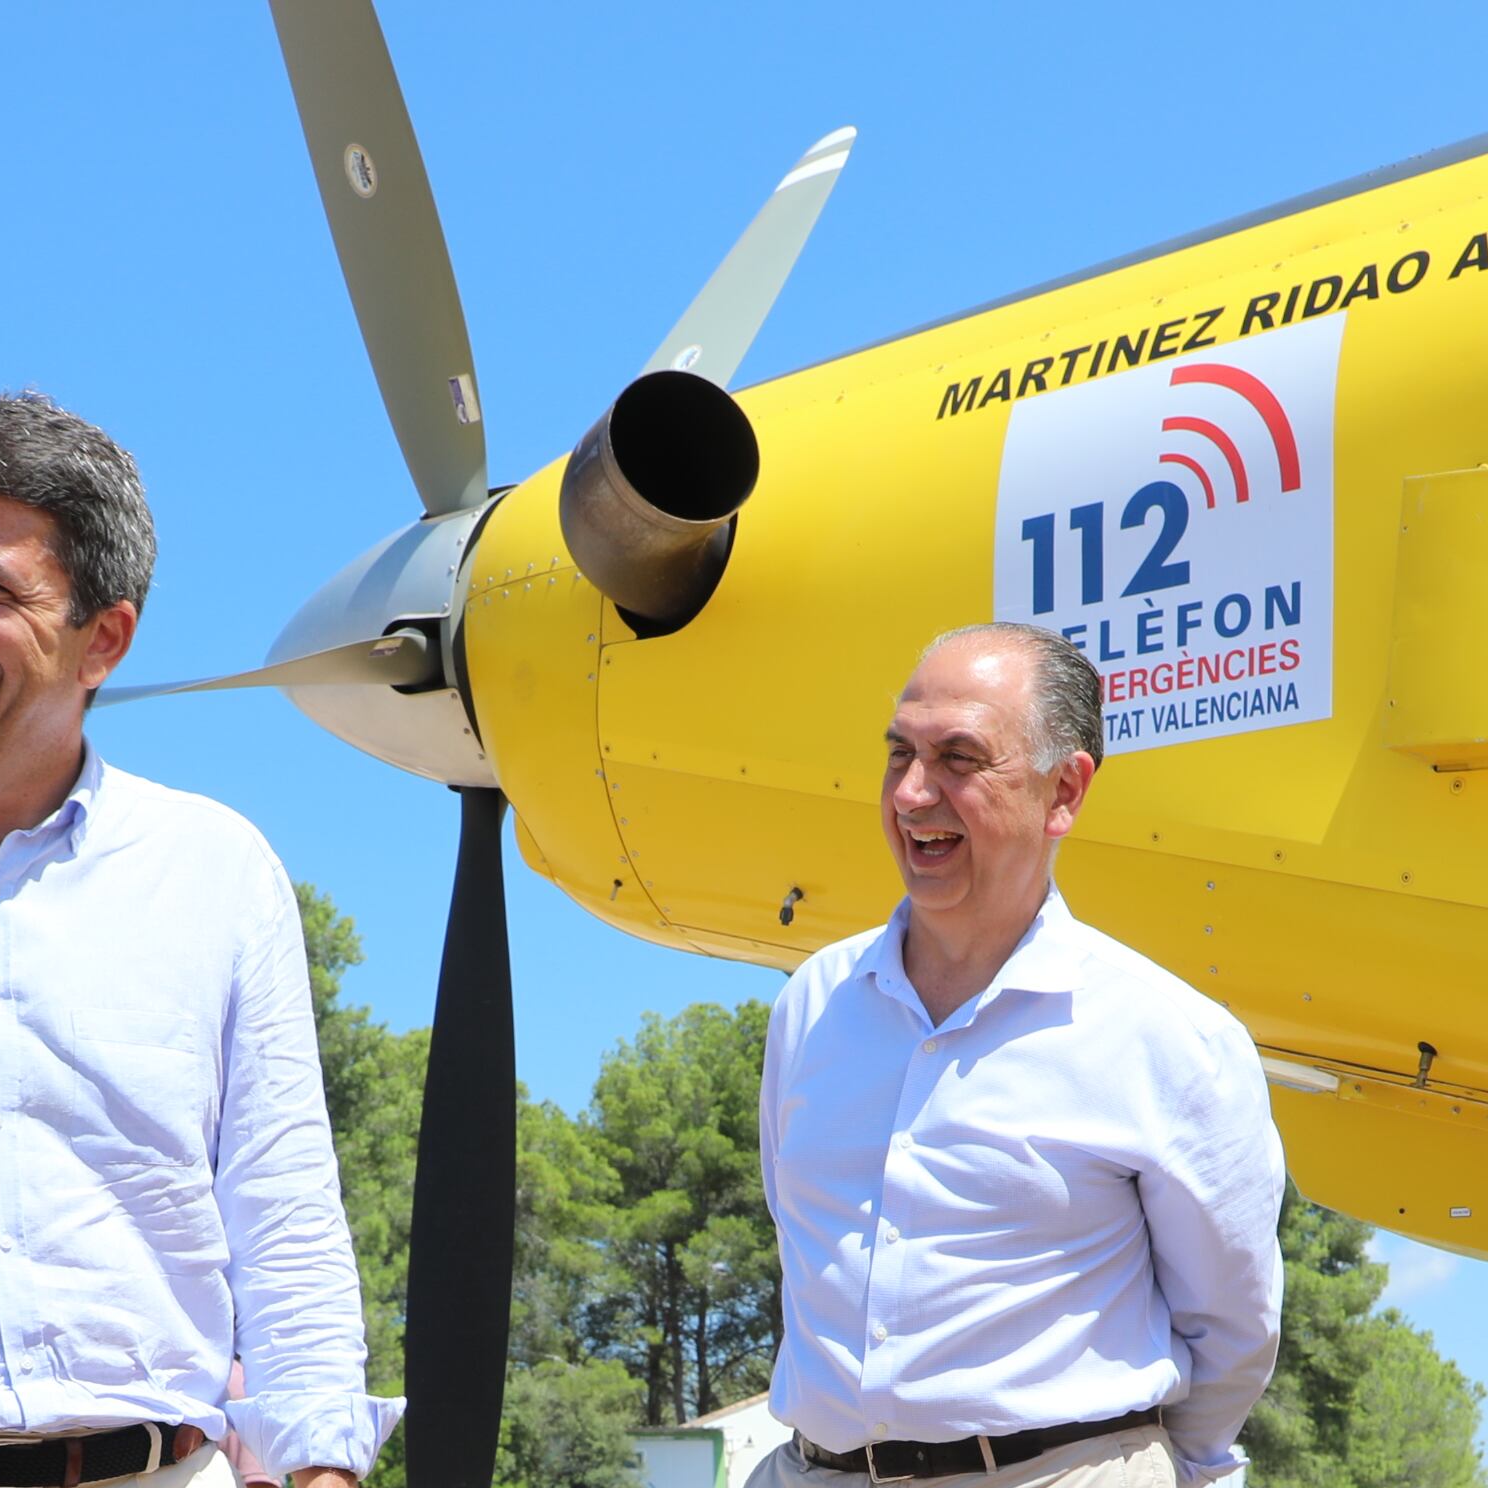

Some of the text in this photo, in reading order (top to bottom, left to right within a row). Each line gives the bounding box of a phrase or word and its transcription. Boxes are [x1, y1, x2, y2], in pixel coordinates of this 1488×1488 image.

[936, 306, 1223, 421] MARTINEZ
[1239, 249, 1430, 337] RIDAO
[1020, 480, 1191, 616] 112
[1061, 580, 1302, 663] ELÈFON
[1151, 681, 1300, 734] VALENCIANA
